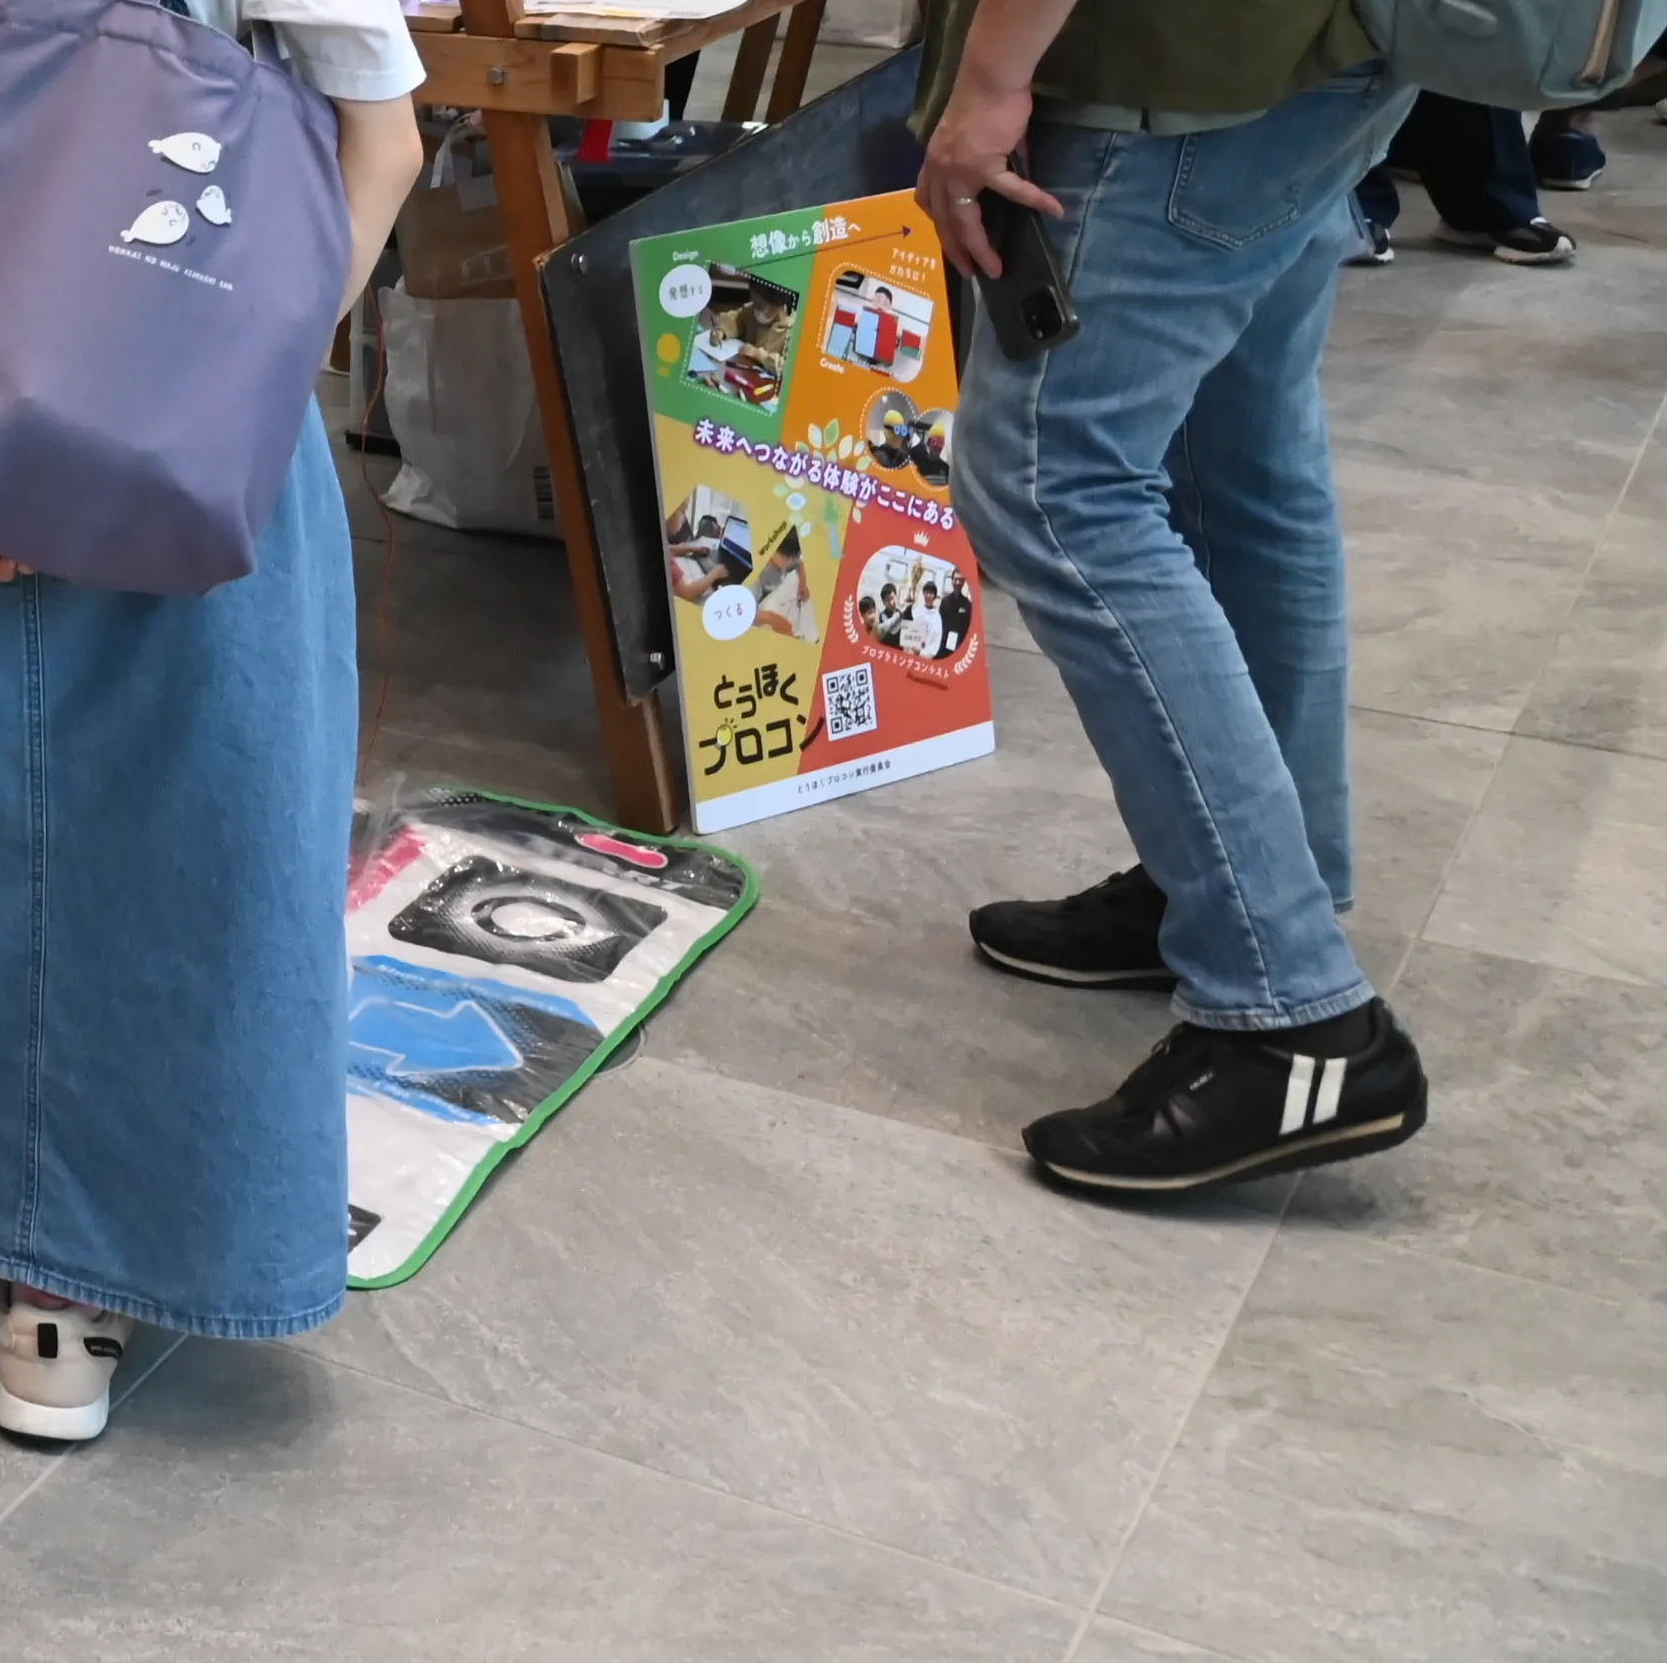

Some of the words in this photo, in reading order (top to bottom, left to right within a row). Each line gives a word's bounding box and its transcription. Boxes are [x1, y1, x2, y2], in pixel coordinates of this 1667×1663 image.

[749, 214, 863, 260] 想像から創造へ
[693, 417, 956, 532] 未来へつながる体験がここにある
[713, 603, 744, 620] つくる
[713, 663, 800, 719] とうほく
[698, 713, 826, 777] プロコン
